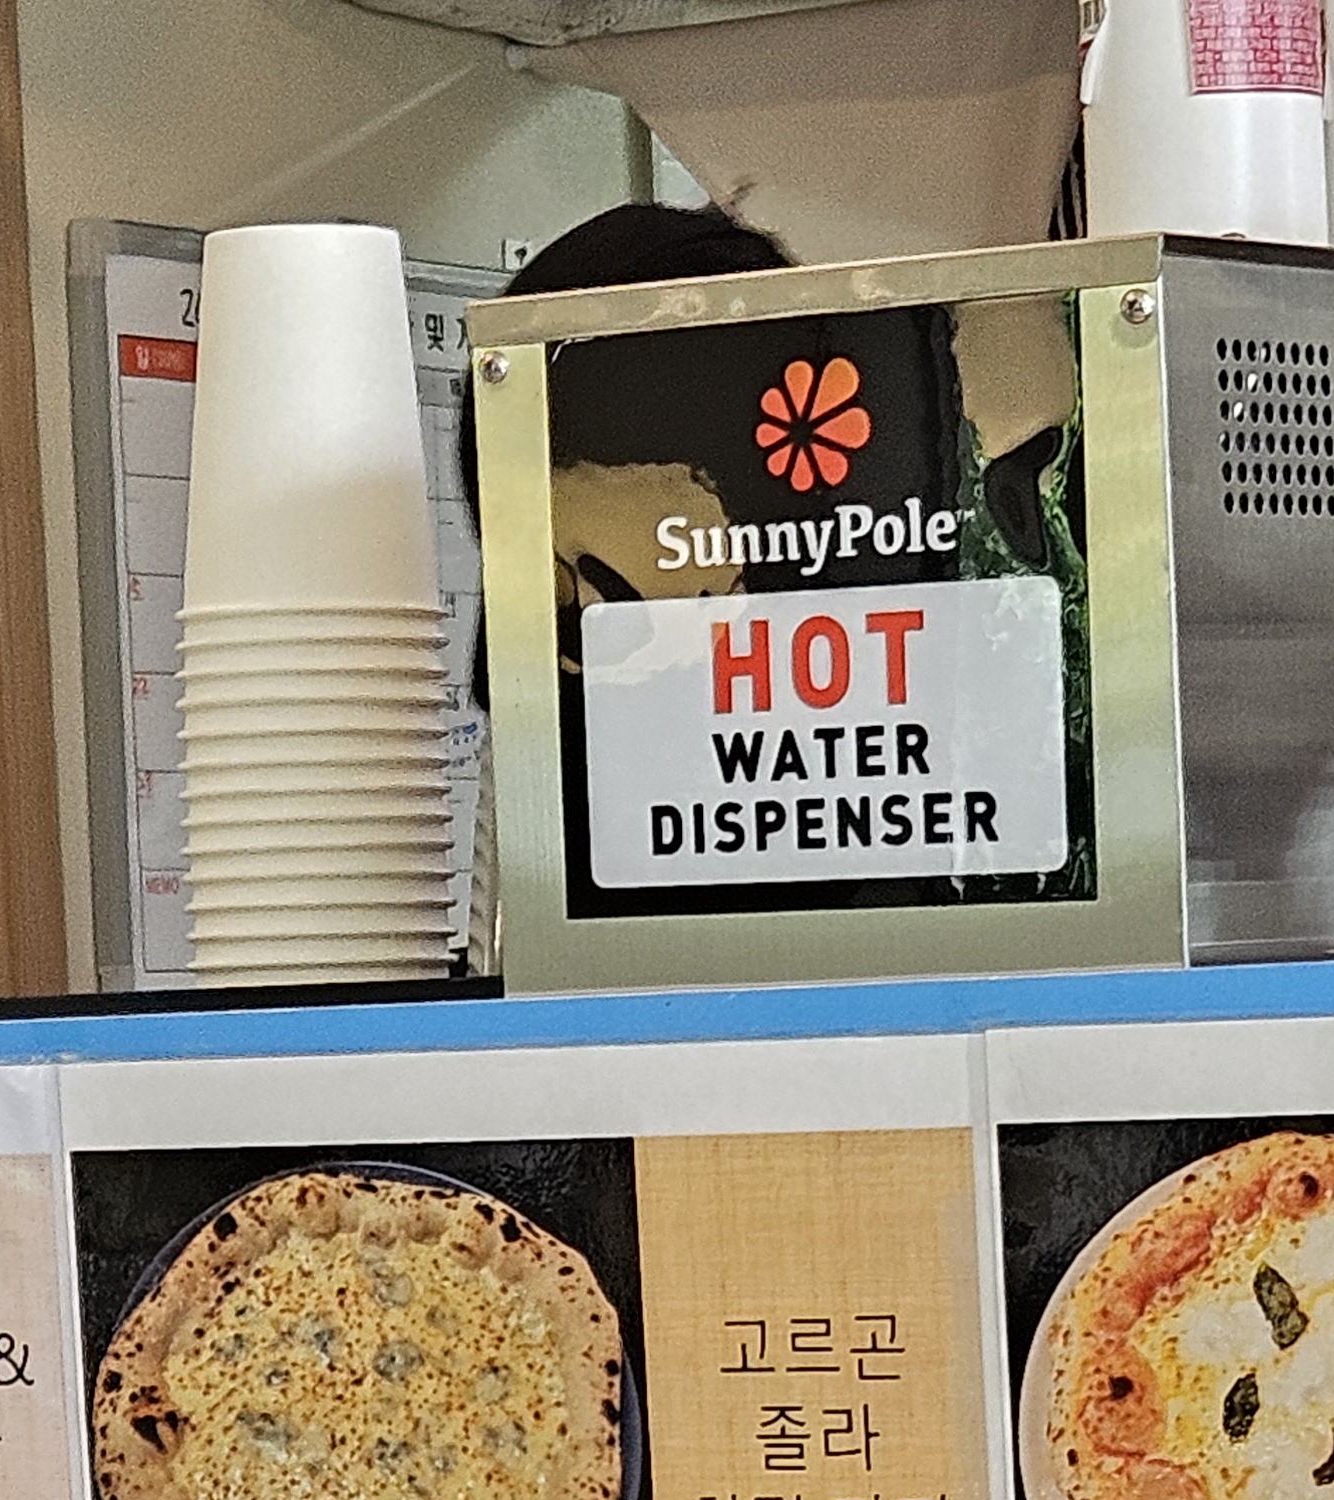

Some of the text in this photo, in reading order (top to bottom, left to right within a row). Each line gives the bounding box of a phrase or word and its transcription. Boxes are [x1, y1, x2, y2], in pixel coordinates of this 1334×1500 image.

[711, 608, 925, 715] HOT
[712, 723, 930, 783] WATER
[651, 791, 999, 856] DISPENSER
[719, 1314, 906, 1381] 고르곤
[755, 1403, 881, 1471] 졸라
